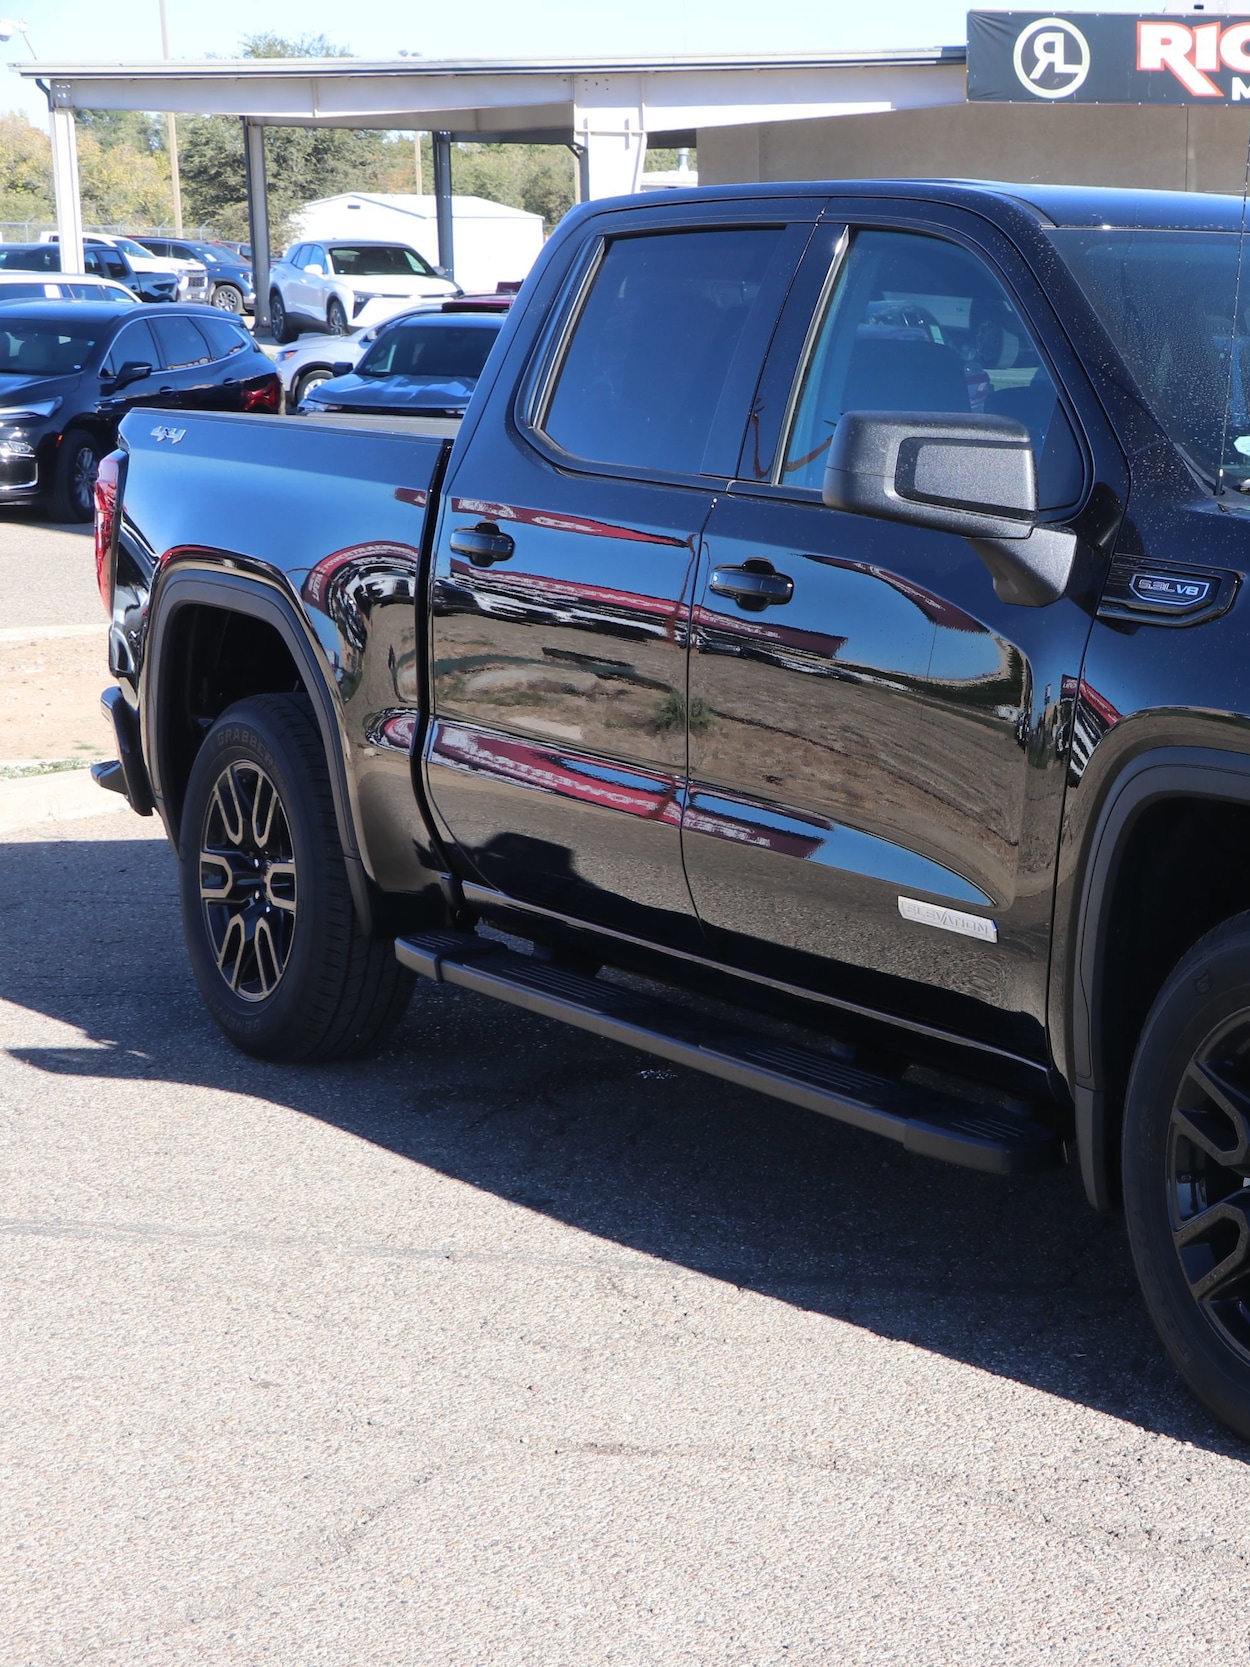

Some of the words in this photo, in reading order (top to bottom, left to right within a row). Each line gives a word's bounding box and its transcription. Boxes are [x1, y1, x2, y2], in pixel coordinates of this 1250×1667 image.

[1176, 584, 1199, 596] V8
[217, 727, 274, 767] GRABBER
[907, 903, 988, 934] ELEVATION
